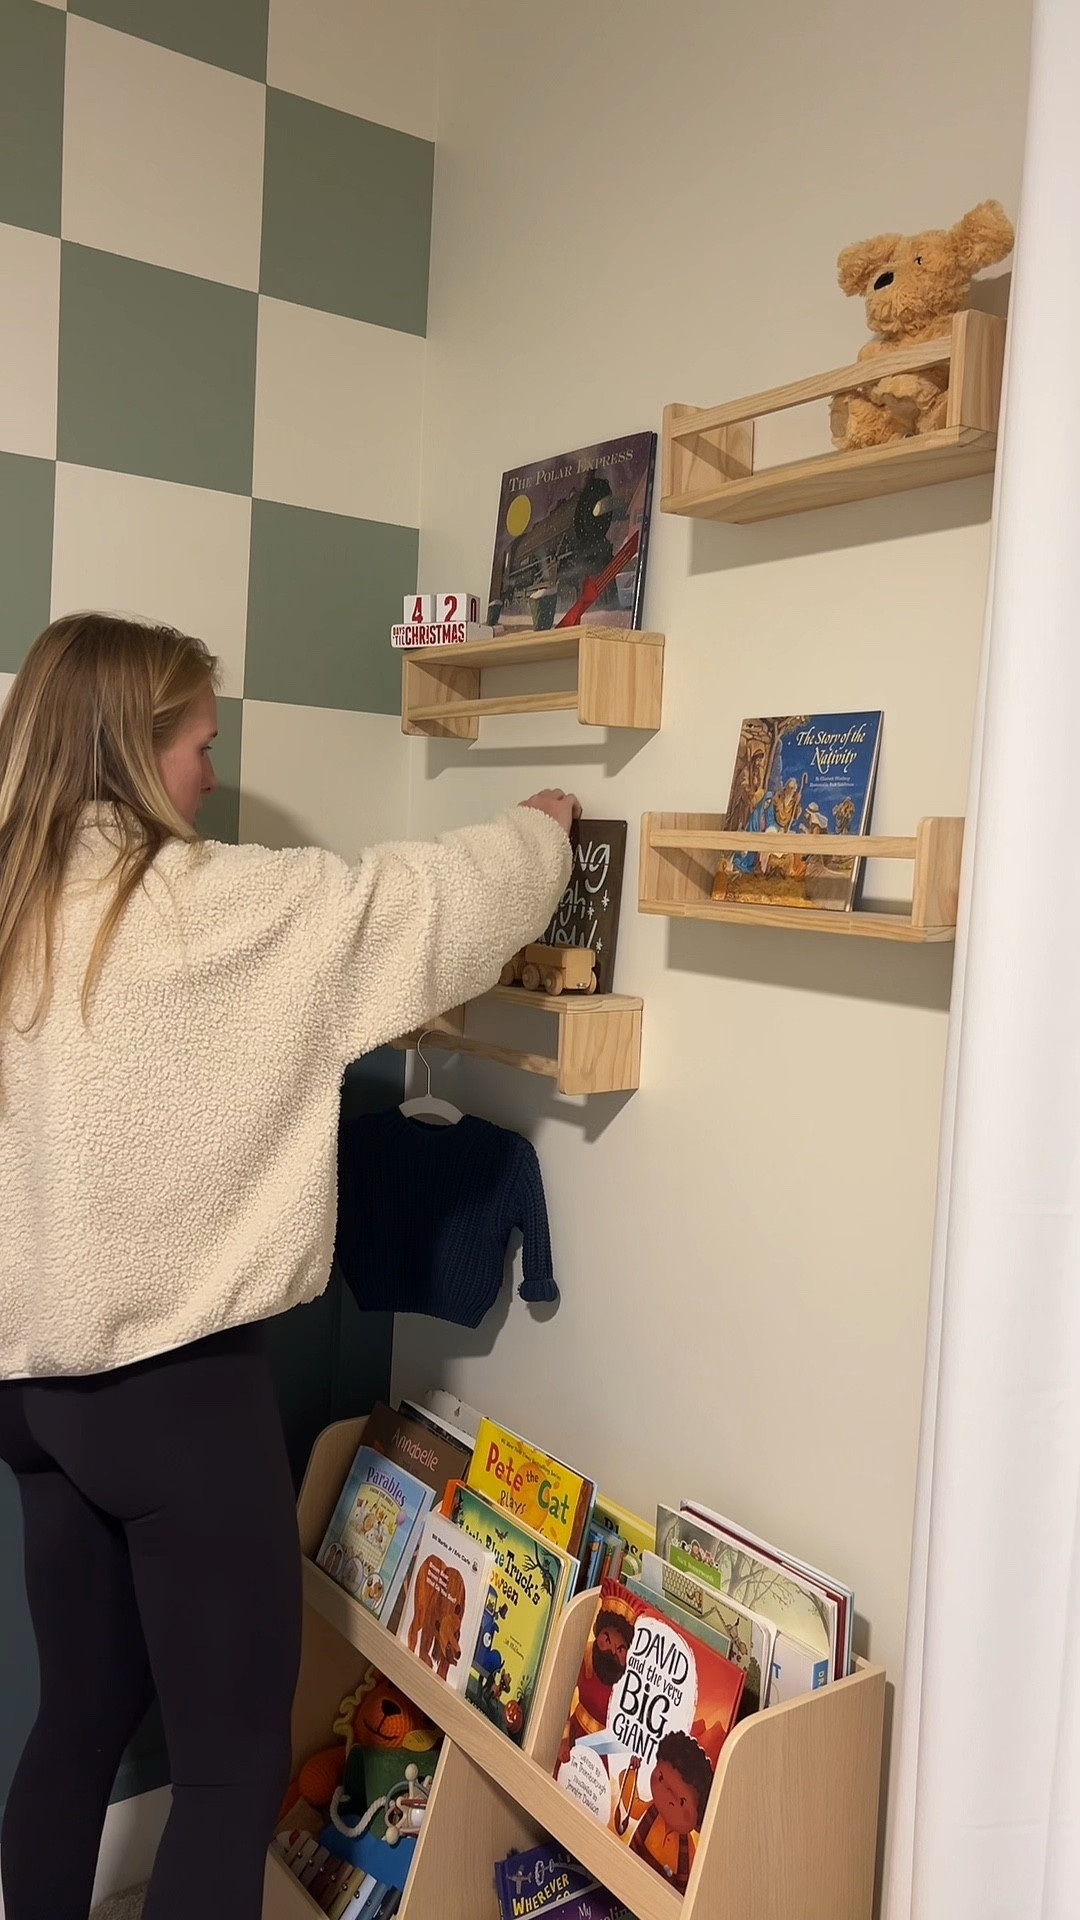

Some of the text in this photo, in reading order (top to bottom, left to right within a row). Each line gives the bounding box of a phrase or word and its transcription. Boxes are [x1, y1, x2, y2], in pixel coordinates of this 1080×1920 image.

[536, 465, 572, 485] POLAR
[576, 449, 634, 474] EXPRESS
[411, 595, 458, 624] 4 2
[405, 623, 465, 645] CHRISTMAS
[796, 723, 867, 751] The Story of the
[810, 747, 857, 774] Nativity
[391, 1427, 439, 1472] Annabelle
[366, 1466, 407, 1507] Parables
[485, 1441, 569, 1525] Pete the Cat
[499, 1490, 526, 1514] Plays
[504, 1549, 541, 1606] Truck's
[633, 1627, 689, 1685] DAVID
[628, 1656, 683, 1707] and the very
[512, 1873, 570, 1916] WHEREVER
